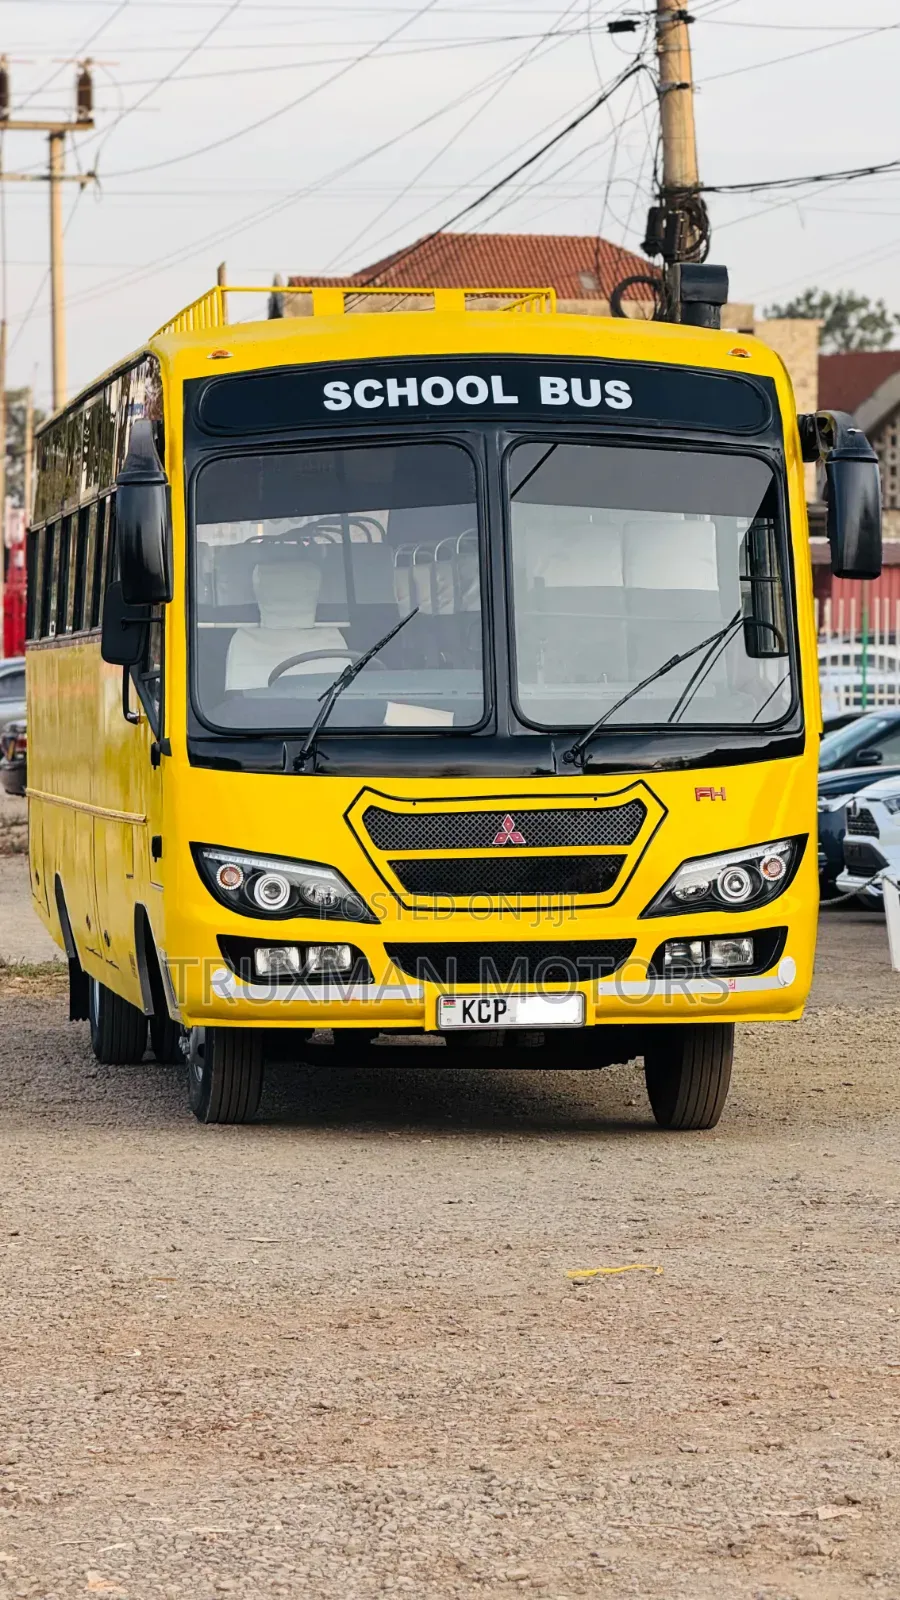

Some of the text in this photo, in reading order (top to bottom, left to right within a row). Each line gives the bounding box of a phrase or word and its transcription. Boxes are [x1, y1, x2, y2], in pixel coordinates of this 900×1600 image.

[323, 375, 632, 411] SCHOOL BUS
[695, 787, 726, 801] FH
[462, 999, 507, 1024] KCP
